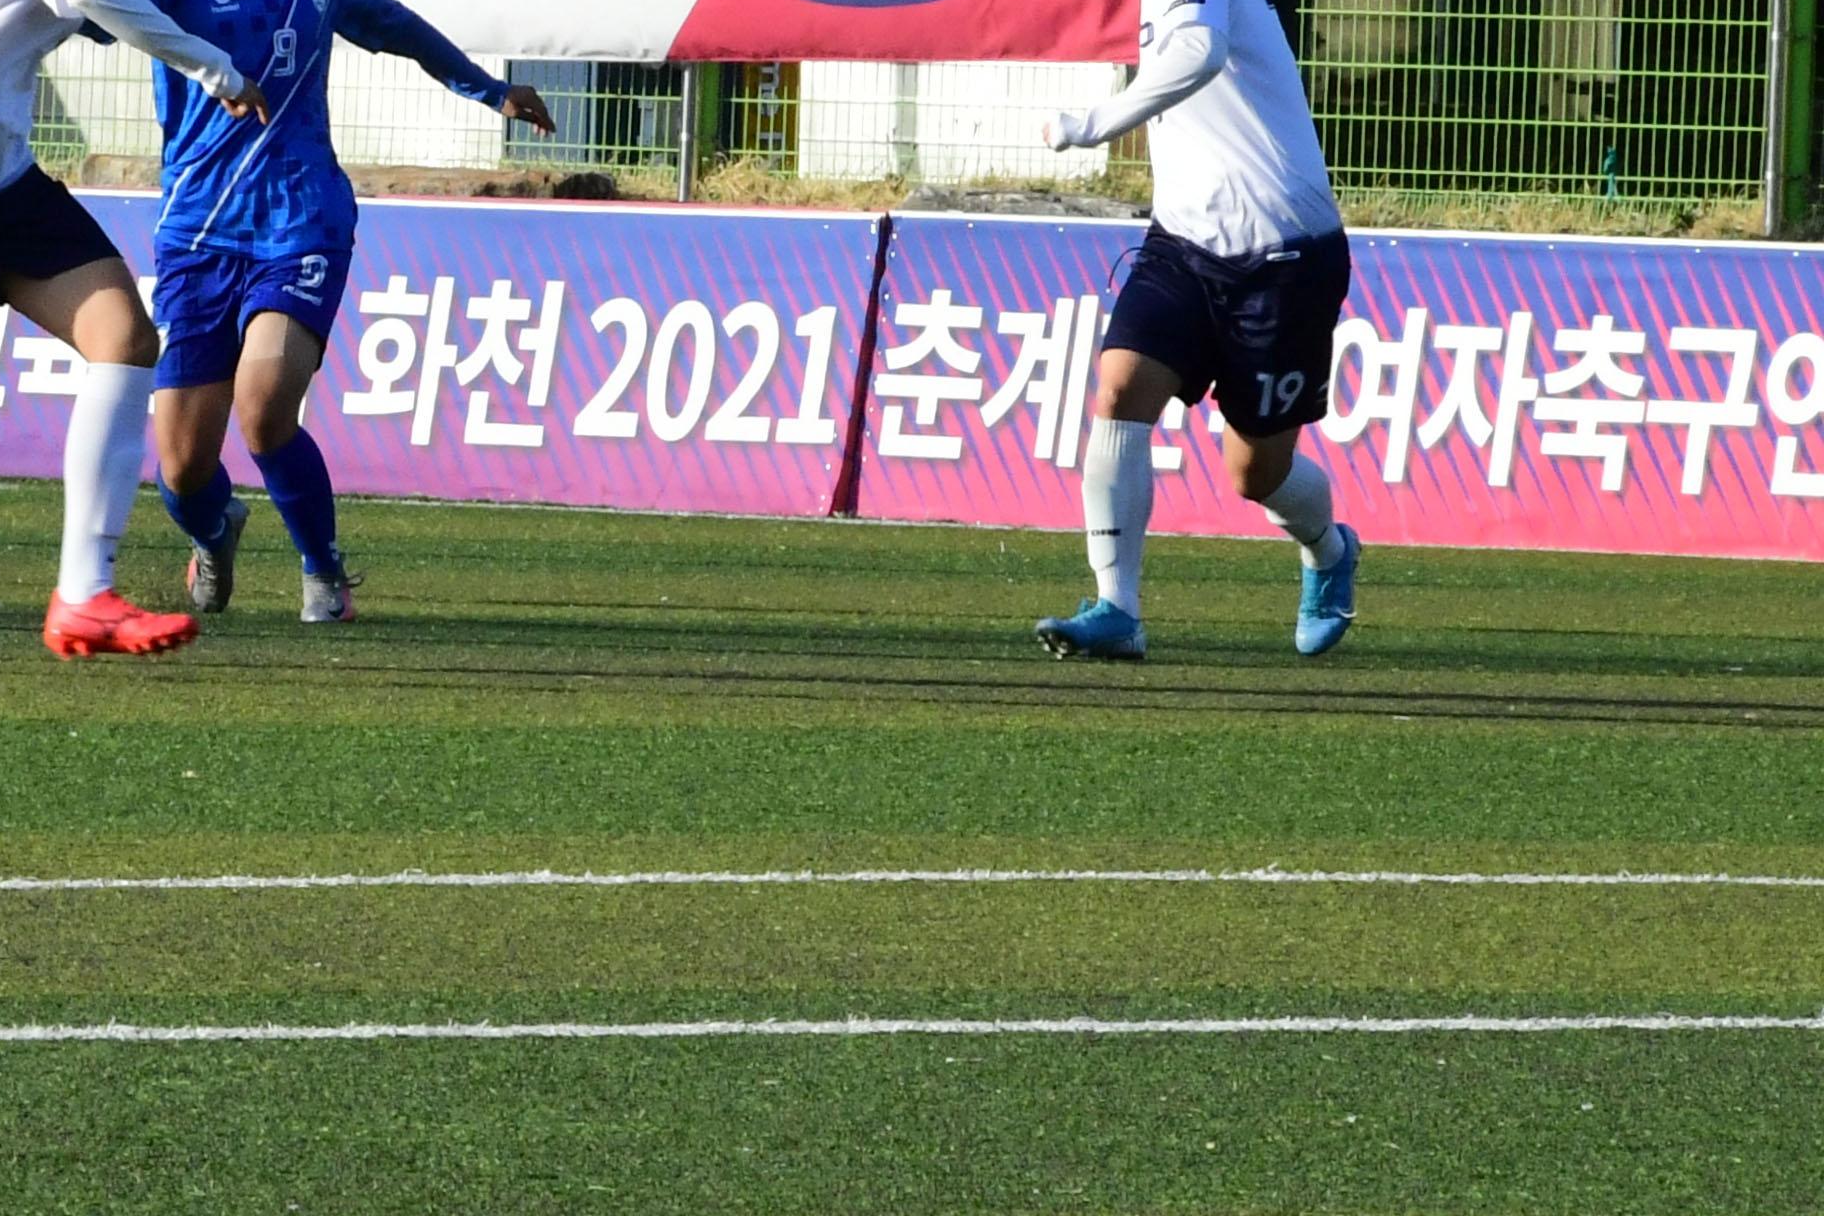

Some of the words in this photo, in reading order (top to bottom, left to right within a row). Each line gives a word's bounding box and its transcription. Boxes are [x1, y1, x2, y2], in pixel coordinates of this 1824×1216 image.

[272, 27, 298, 77] 9
[342, 274, 565, 448] 화천
[572, 297, 839, 446] 2021
[1255, 369, 1306, 418] 19
